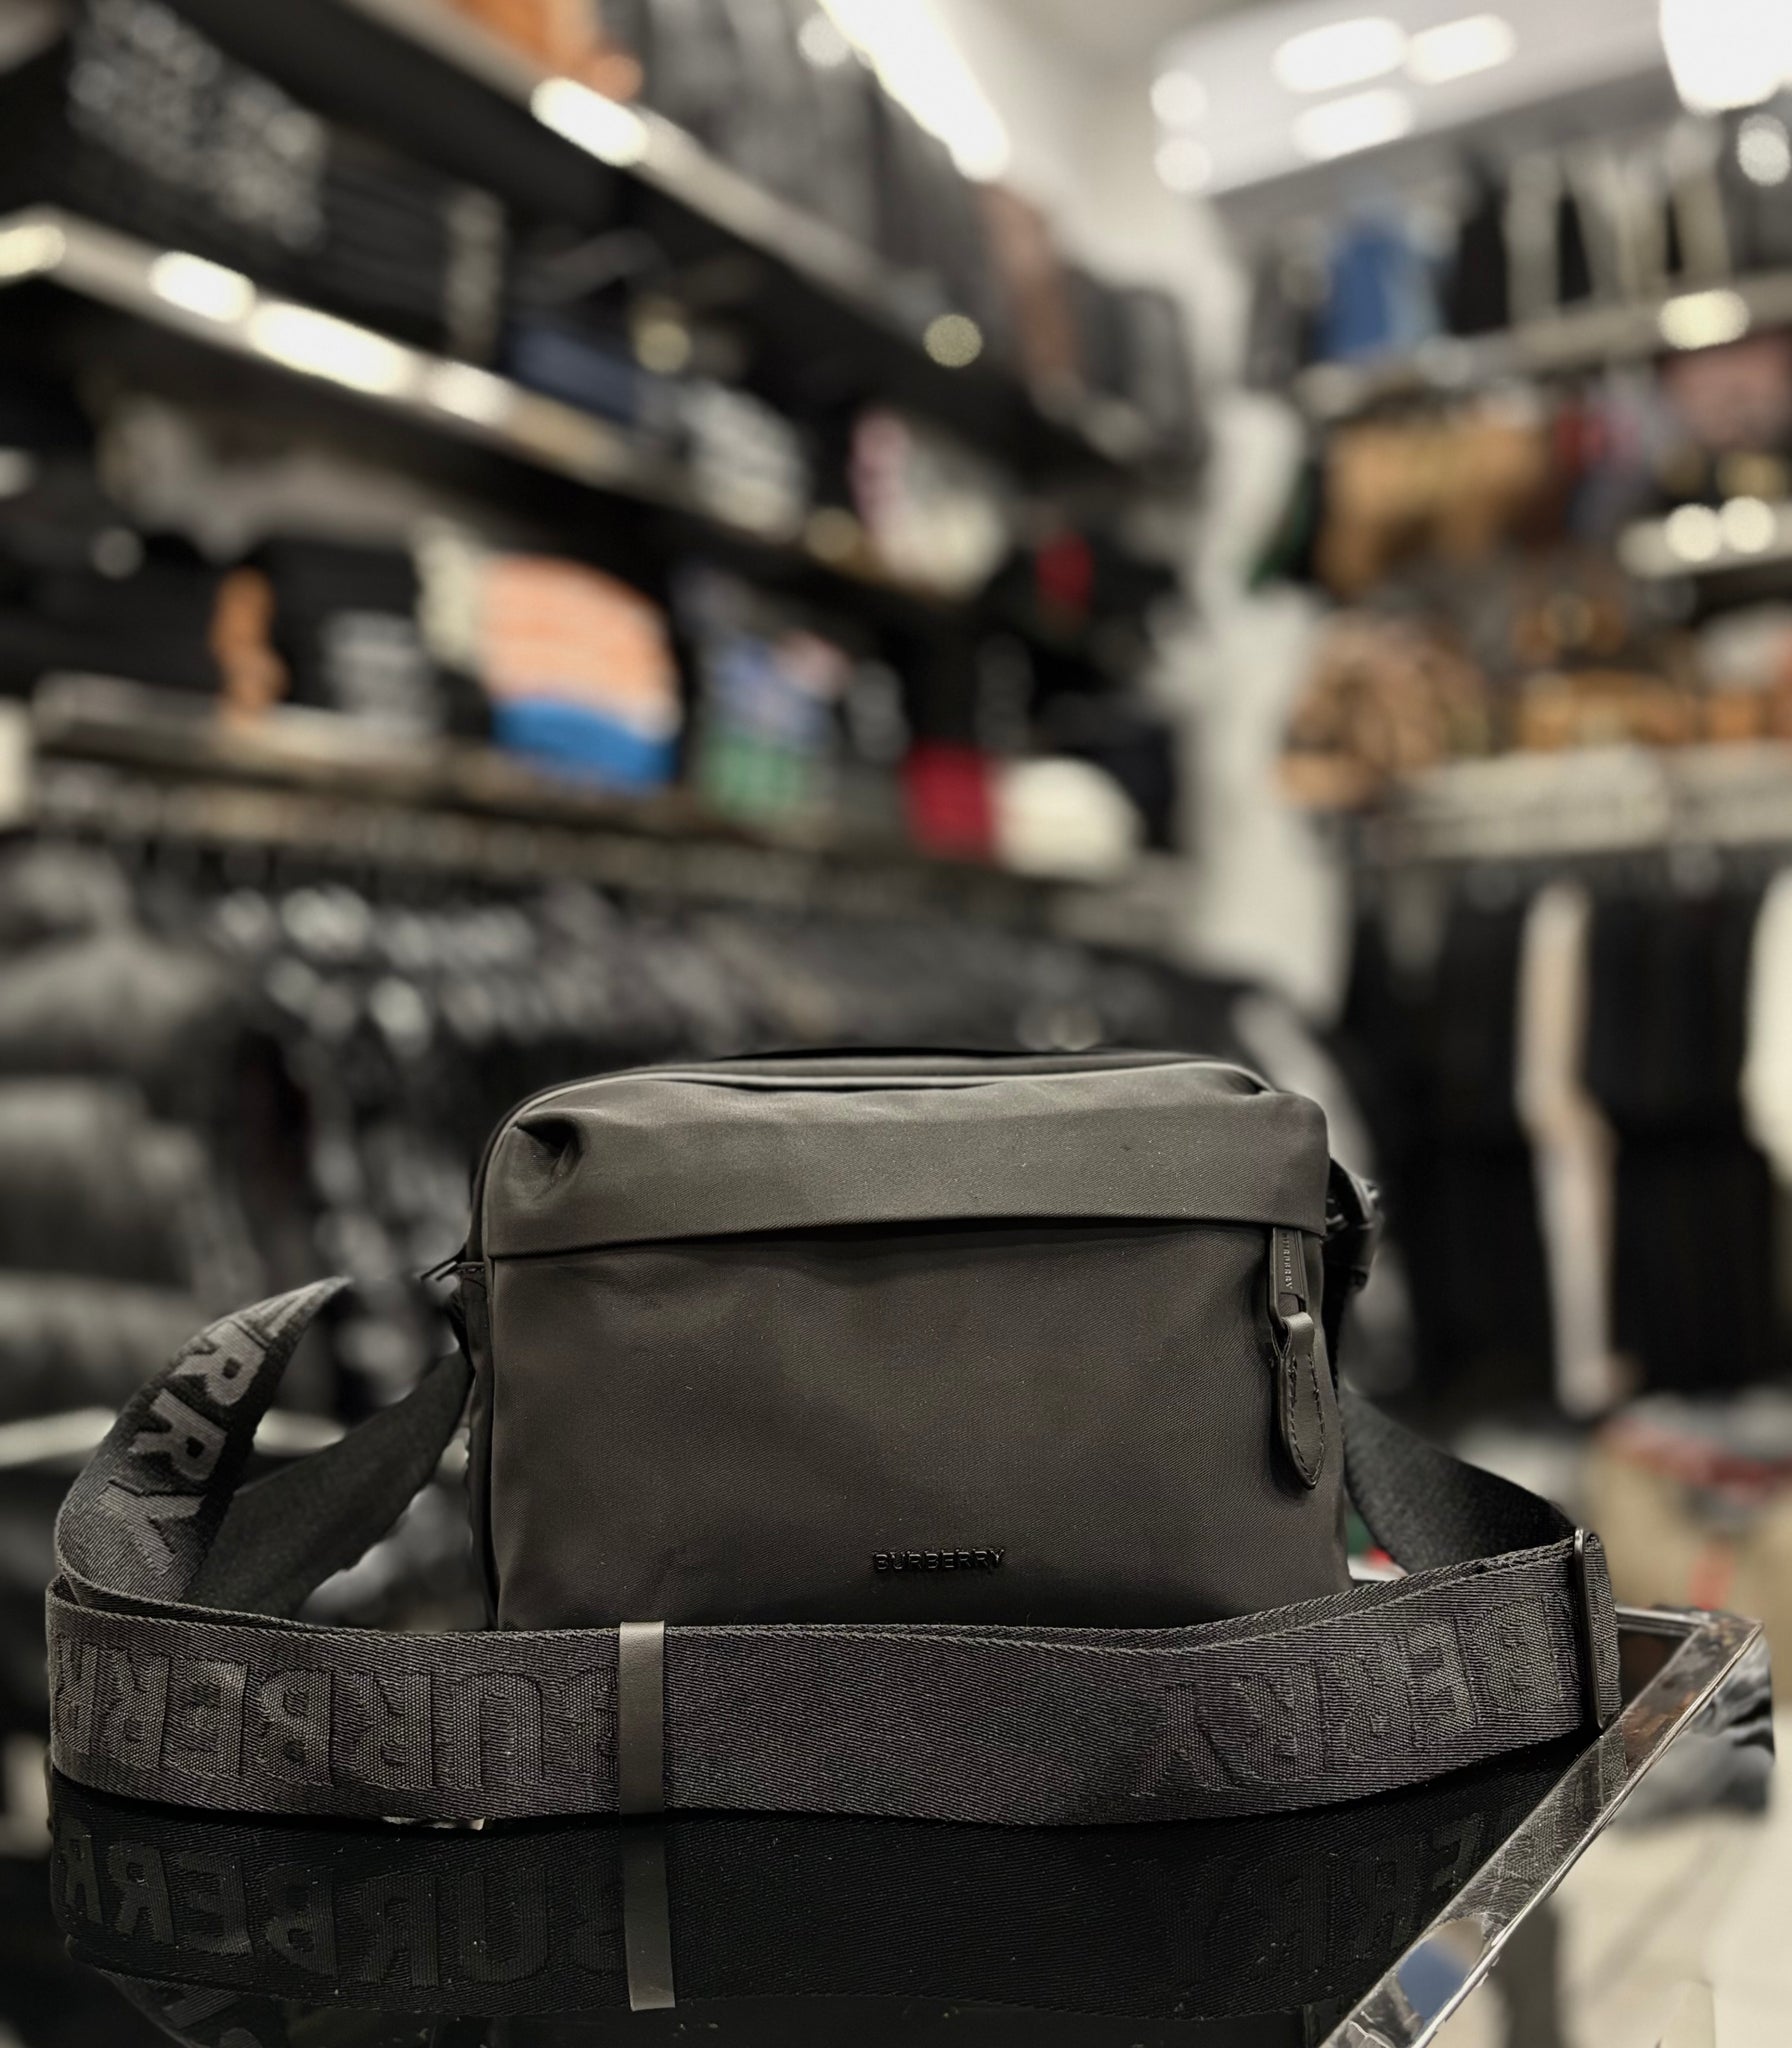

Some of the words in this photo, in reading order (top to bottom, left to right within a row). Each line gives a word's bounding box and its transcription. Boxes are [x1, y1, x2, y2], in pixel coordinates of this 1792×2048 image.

[872, 1548, 1006, 1572] BURBERRY
[53, 1638, 620, 1791] BURBERR
[1127, 1592, 1604, 1798] BERRY
